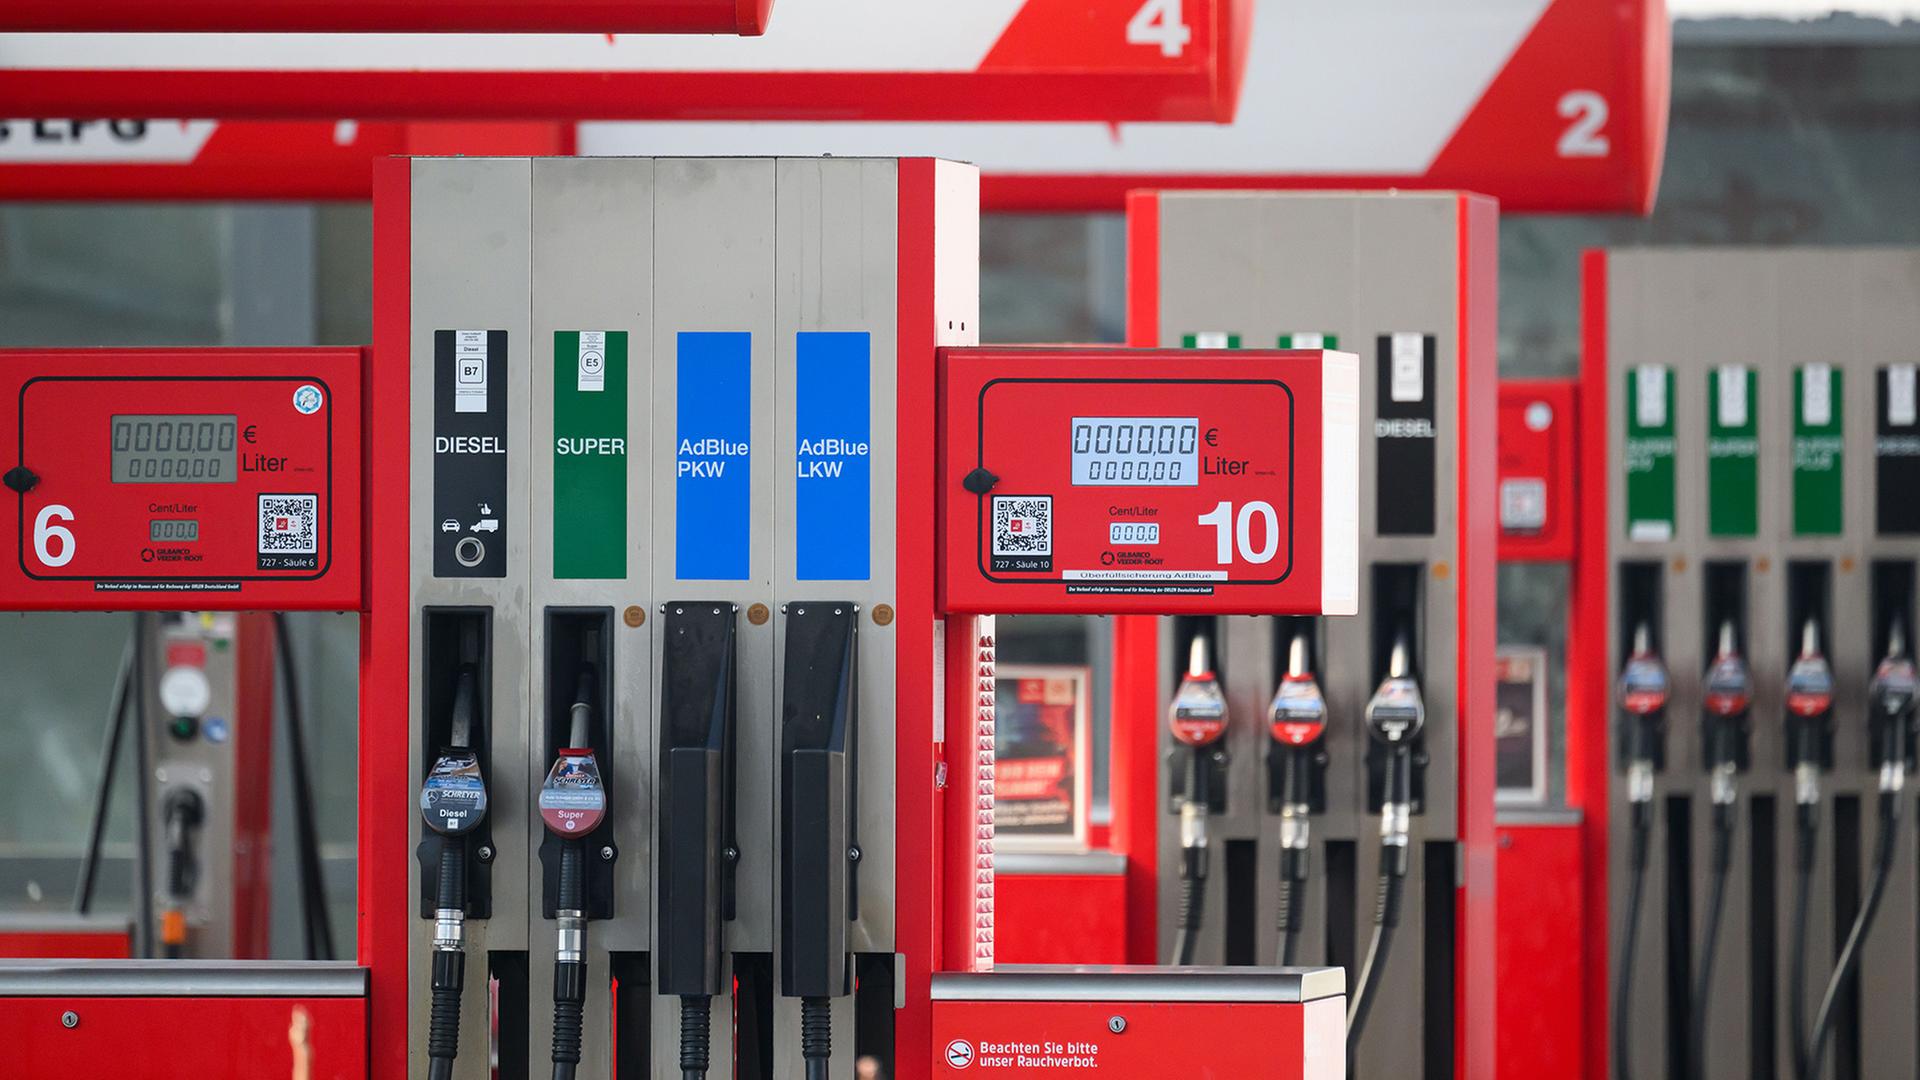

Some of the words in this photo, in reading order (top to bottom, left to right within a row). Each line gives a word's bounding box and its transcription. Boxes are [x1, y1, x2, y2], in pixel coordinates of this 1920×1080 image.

[1126, 0, 1191, 57] 4
[1556, 90, 1610, 158] 2
[585, 357, 599, 367] E5
[464, 366, 479, 376] B7
[242, 425, 257, 443] €
[1376, 418, 1437, 438] DIESEL
[435, 436, 506, 454] DIESEL
[556, 437, 625, 455] SUPER
[1204, 428, 1219, 447] €
[678, 438, 749, 456] AdBlue
[798, 438, 869, 456] AdBlue
[242, 453, 288, 472] Liter
[678, 461, 725, 478] PKW
[798, 461, 843, 478] LKW
[1203, 457, 1249, 475] Liter
[148, 503, 198, 513] Cent/Liter
[1108, 505, 1158, 516] Cent/Liter
[33, 504, 76, 567] 6
[1198, 500, 1279, 565] 10
[261, 558, 277, 567] 727
[283, 558, 307, 567] Säule
[308, 558, 315, 567] 6
[995, 560, 1009, 569] 727
[1016, 560, 1038, 569] Säule
[1039, 560, 1050, 569] 10
[441, 790, 480, 799] SCHREYER
[439, 809, 467, 818] Diesel
[558, 809, 584, 819] Super
[980, 1041, 1040, 1054] Beachten
[1044, 1041, 1064, 1054] Sie
[1067, 1042, 1099, 1054] bitte
[980, 1057, 1013, 1067] unser
[1017, 1055, 1099, 1067] Rauchverbot.
